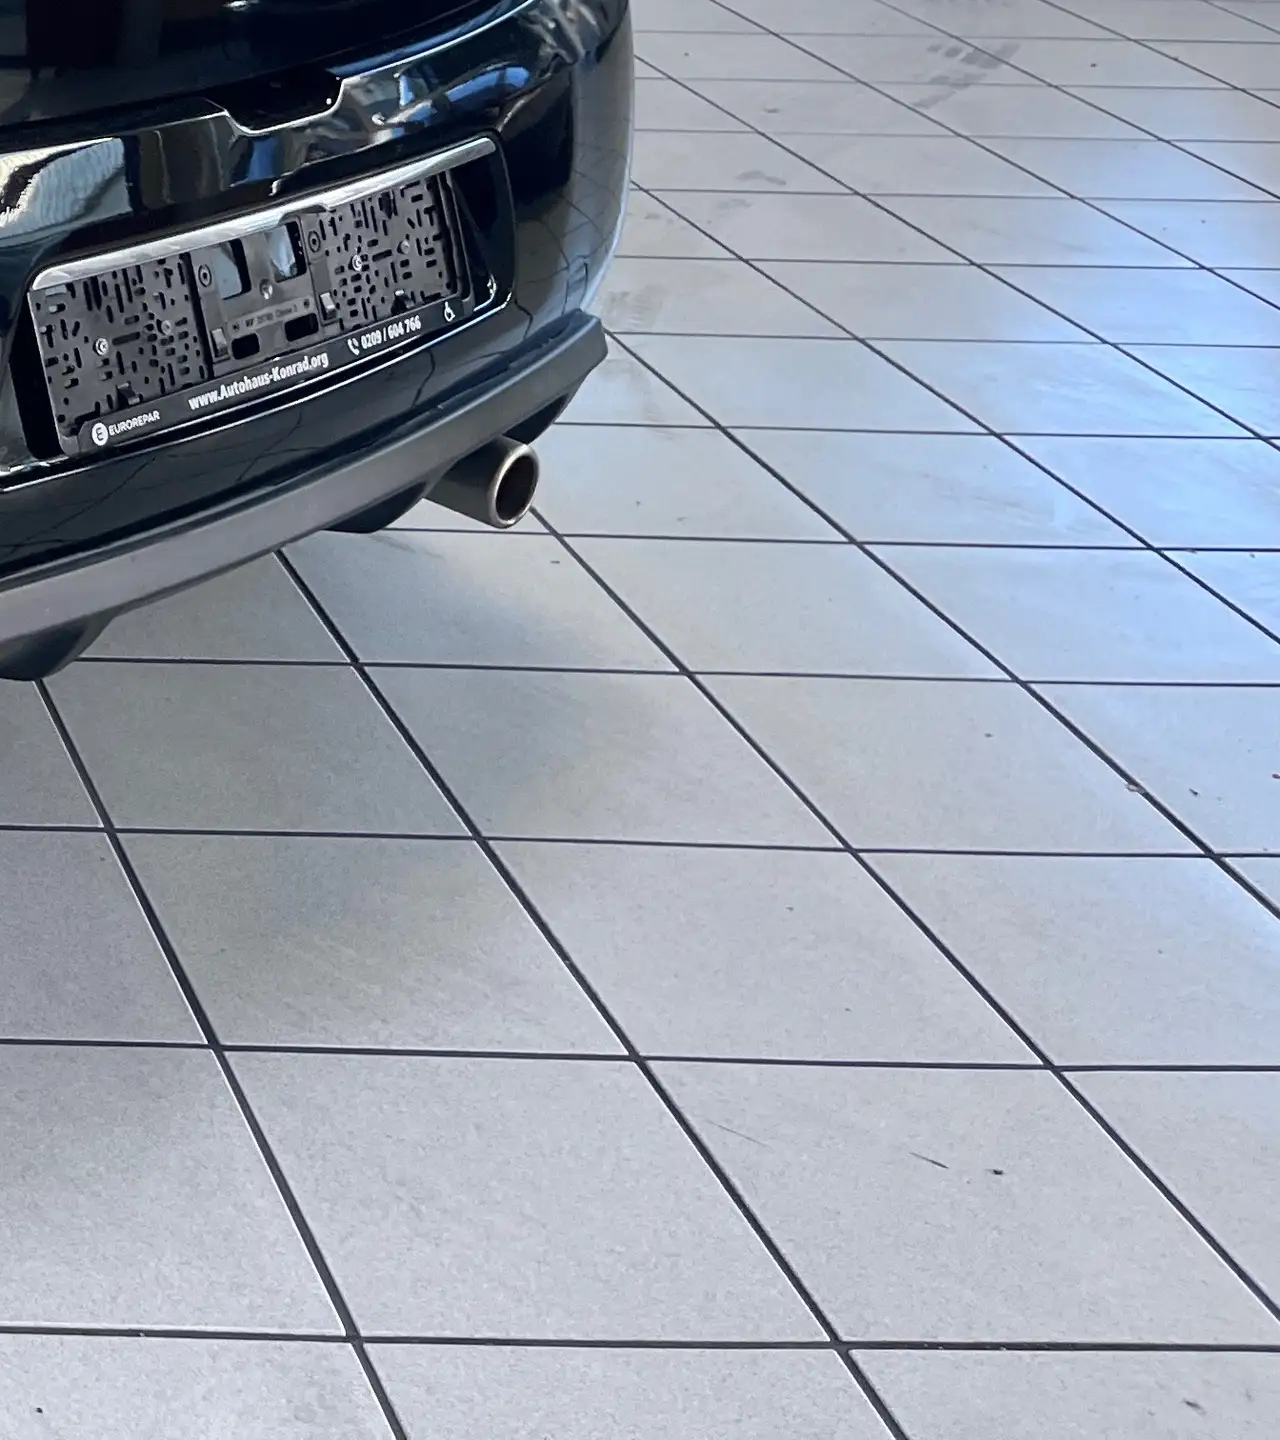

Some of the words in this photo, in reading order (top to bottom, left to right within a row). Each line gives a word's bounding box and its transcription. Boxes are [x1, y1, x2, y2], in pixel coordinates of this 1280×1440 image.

[361, 329, 382, 349] 0209
[188, 352, 329, 410] www.Autohaus-Konrad.org
[108, 410, 160, 436] EUROREPAR
